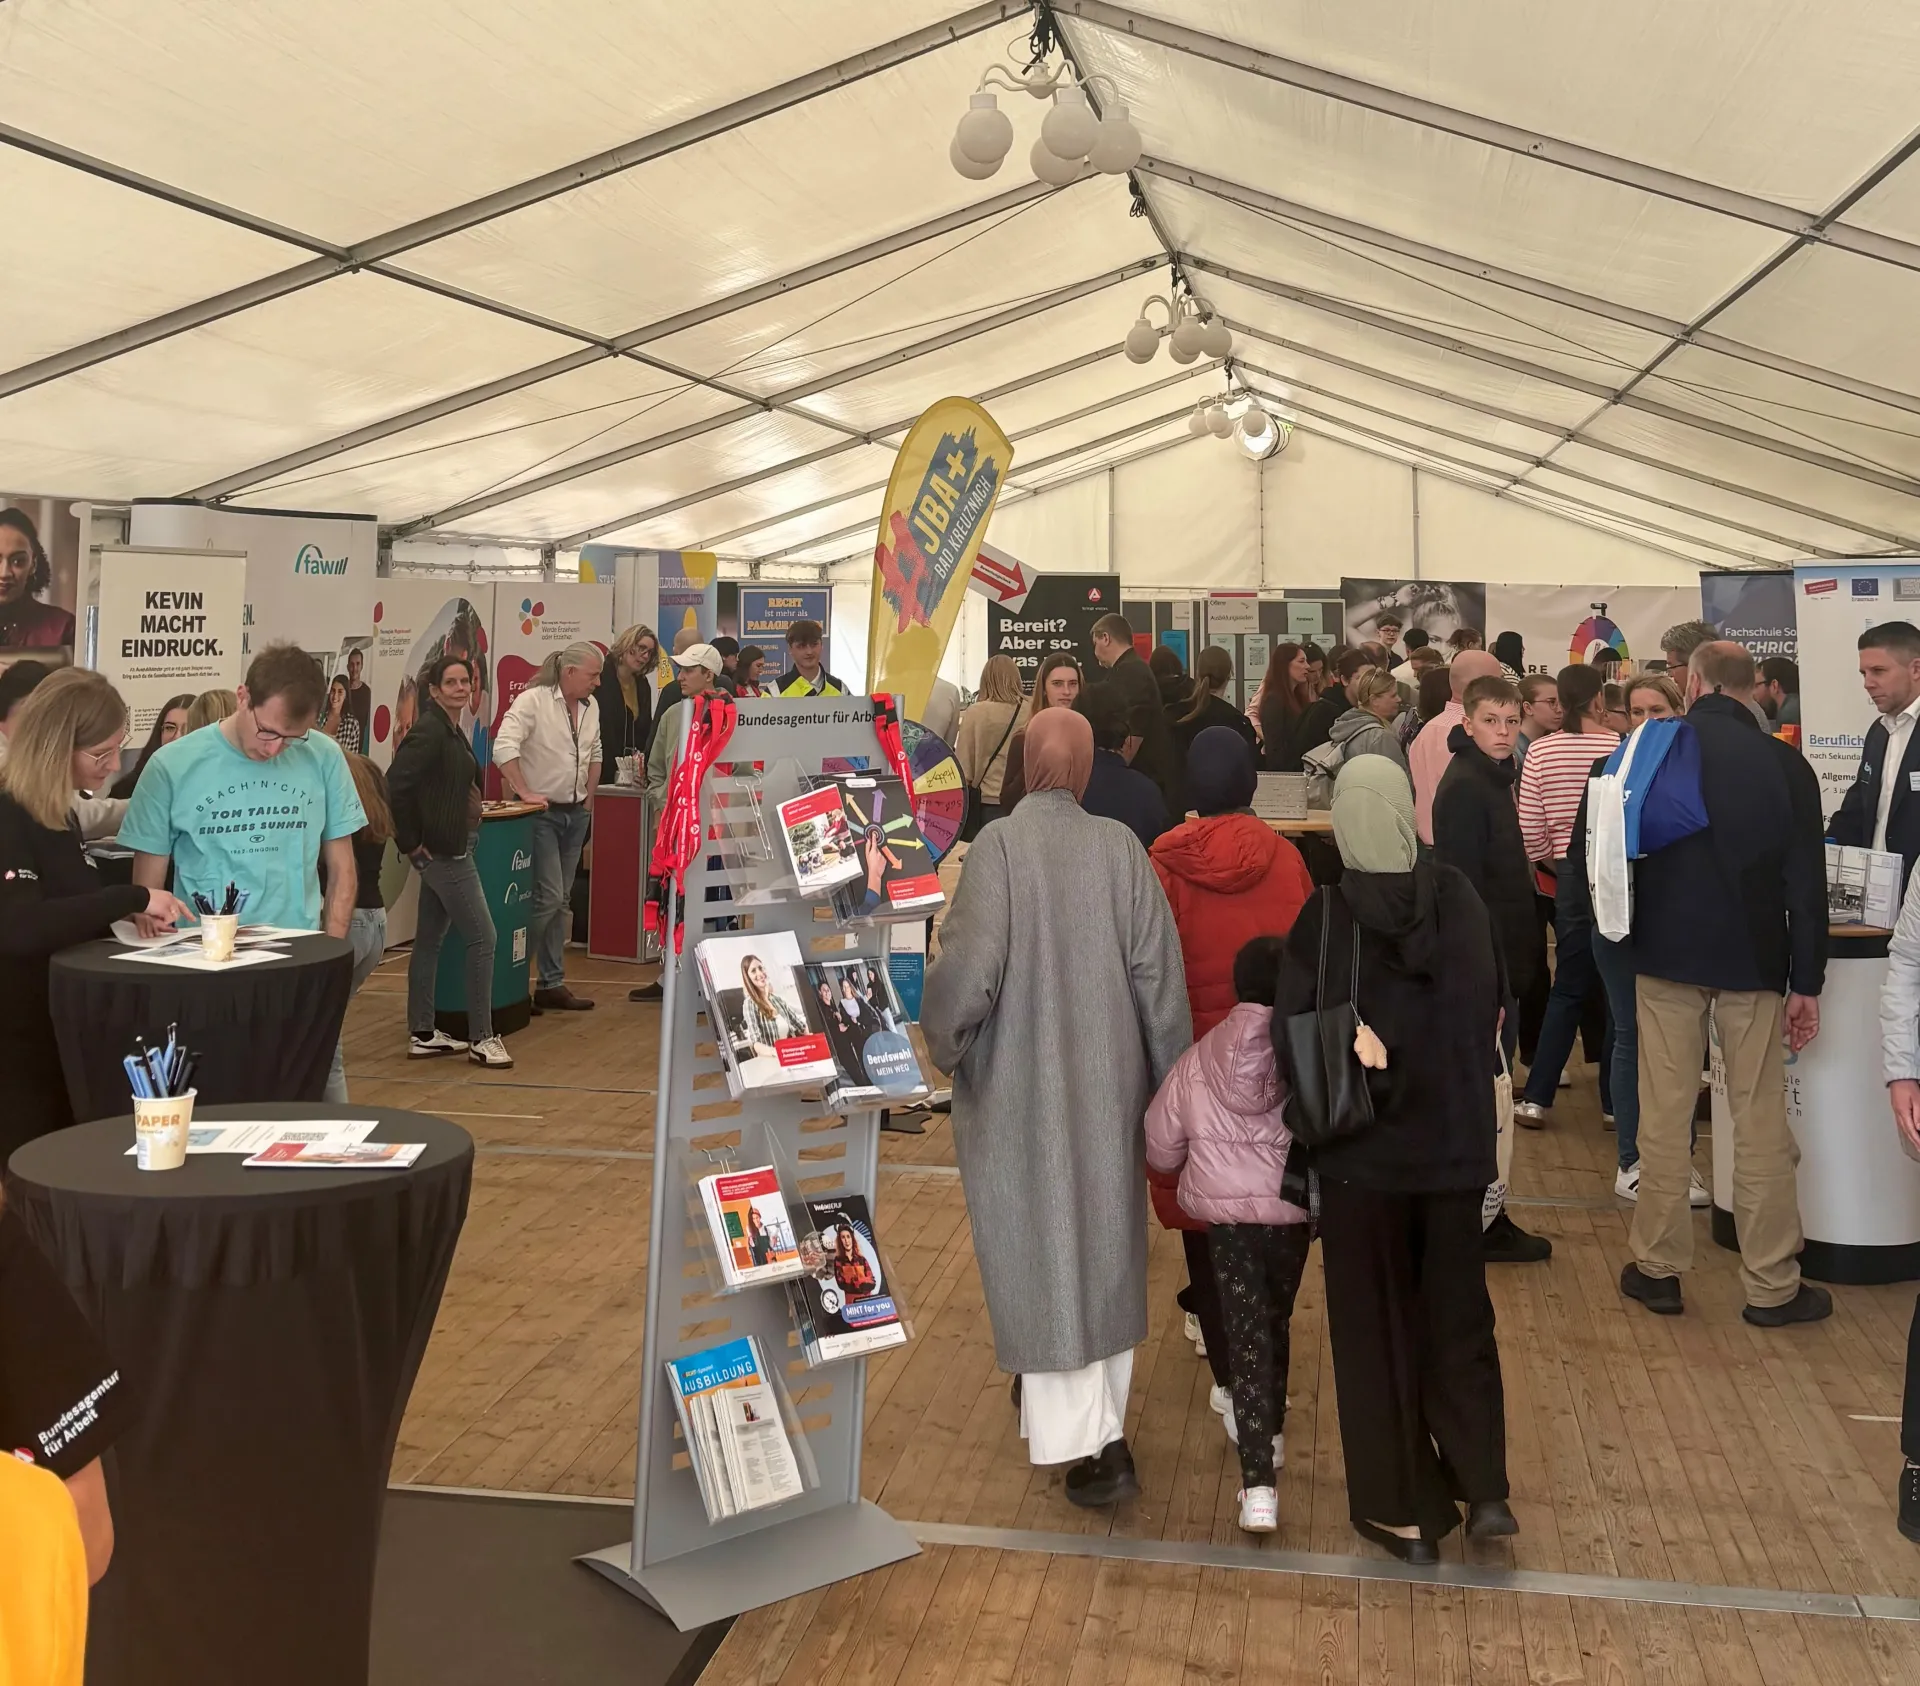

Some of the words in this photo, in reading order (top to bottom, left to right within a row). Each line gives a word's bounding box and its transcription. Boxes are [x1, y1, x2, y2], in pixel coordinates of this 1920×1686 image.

[934, 548, 954, 579] BAD
[948, 475, 992, 552] KREUZNACH
[598, 574, 615, 584] STAR
[658, 577, 681, 588] ILDUNG
[145, 592, 203, 610] KEVIN
[768, 598, 803, 608] RECHT
[765, 609, 774, 617] ist
[797, 609, 808, 617] als
[140, 615, 206, 633] MACHT
[1000, 618, 1067, 633] Bereit?
[1725, 627, 1782, 637] Fachschule
[1784, 627, 1797, 637] So
[121, 639, 223, 658] EINDRUCK.
[999, 636, 1045, 650] Aber
[1050, 638, 1078, 650] so-
[1737, 641, 1798, 654] ACHRIC
[737, 712, 831, 728] Bundesagentur
[832, 710, 850, 723] für
[852, 710, 877, 723] Arbe
[212, 810, 242, 820] TOM
[248, 805, 300, 817] TAILOR
[199, 822, 256, 835] ENDLESS
[260, 821, 308, 830] SUMMER
[867, 1048, 912, 1066] Berufswahl
[876, 1066, 893, 1076] MEIN
[895, 1064, 910, 1073] WEG
[136, 1114, 180, 1127] PAPER
[846, 1305, 863, 1317] MINT
[864, 1304, 875, 1313] for
[876, 1302, 891, 1313] you
[684, 1361, 753, 1394] AUSBILDUNG
[38, 1370, 120, 1445] Bundesagentur
[44, 1438, 63, 1458] für
[63, 1408, 99, 1443] Arbeit
